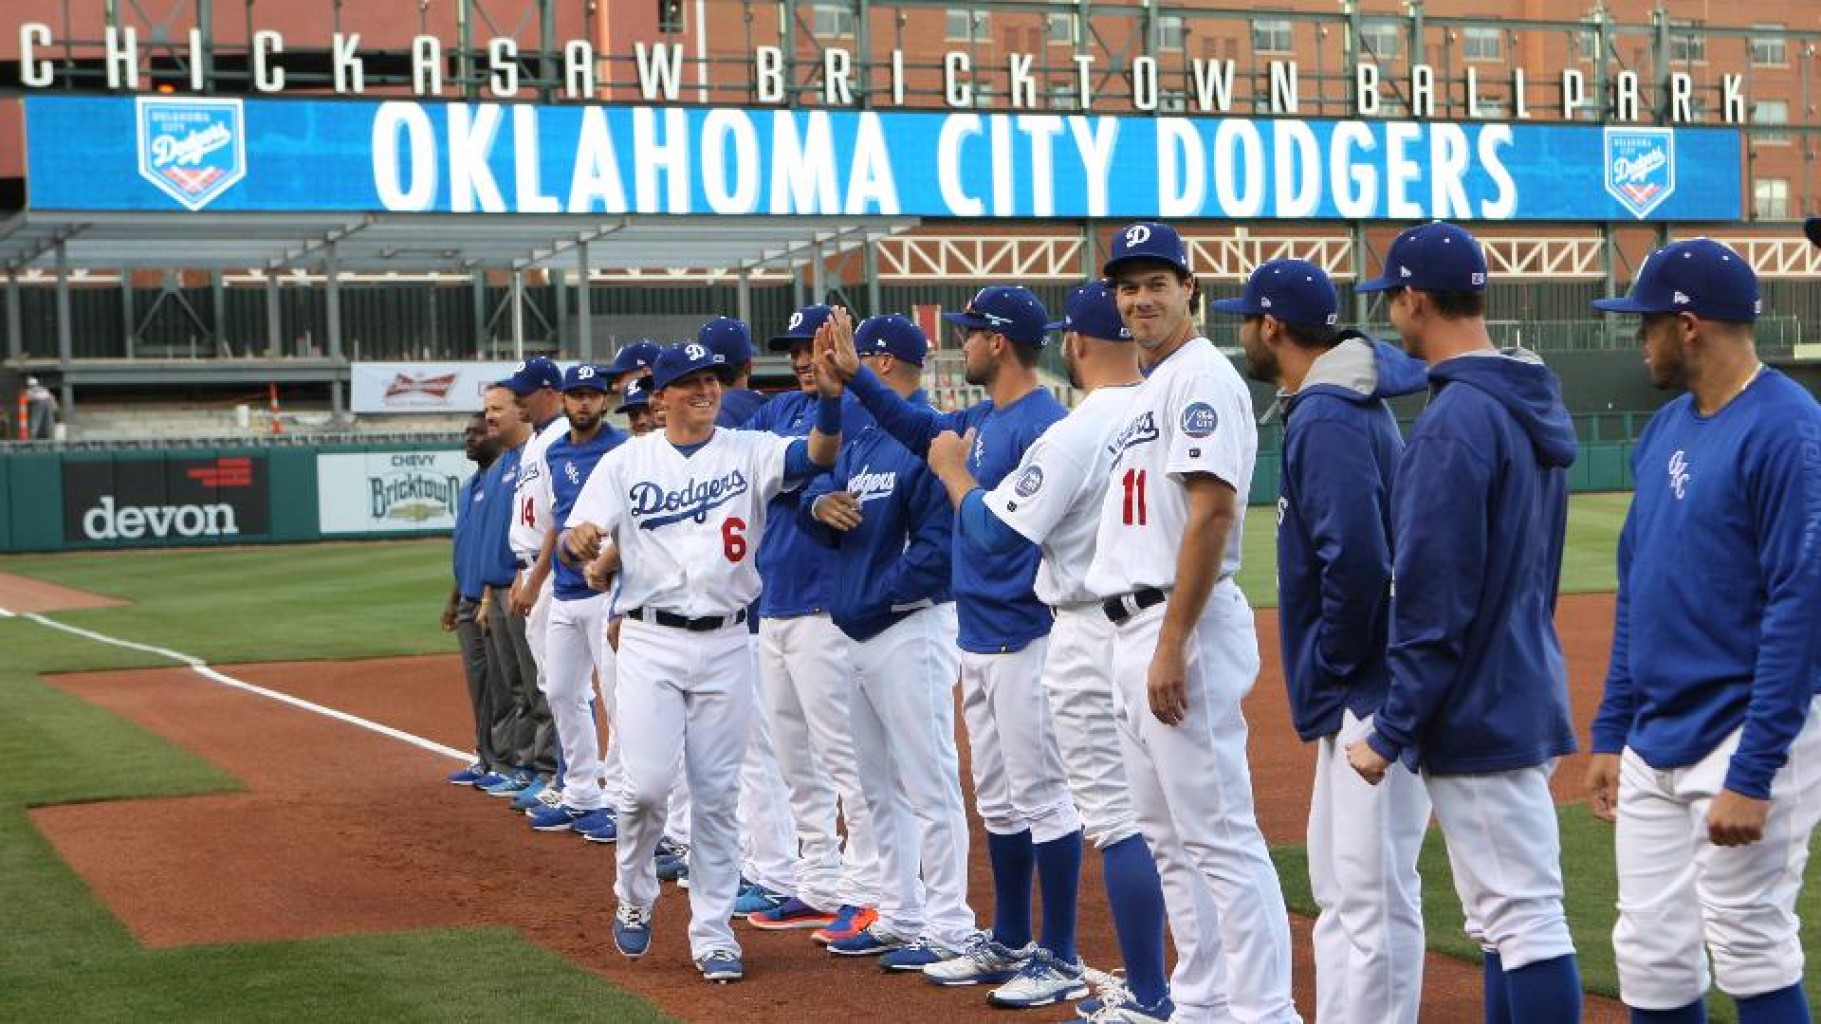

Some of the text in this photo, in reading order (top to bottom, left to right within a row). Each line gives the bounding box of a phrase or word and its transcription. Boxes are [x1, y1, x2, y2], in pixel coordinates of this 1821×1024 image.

[20, 22, 1744, 123] CHICKASAW BRICKTOWN BALLPARK
[371, 101, 1518, 220] OKLAHOMA CITY DODGERS
[391, 454, 436, 467] CHEVY
[83, 496, 238, 539] devon
[521, 496, 536, 529] 14
[629, 468, 748, 526] Dodgers
[1122, 468, 1147, 526] 11
[722, 517, 747, 563] 6
